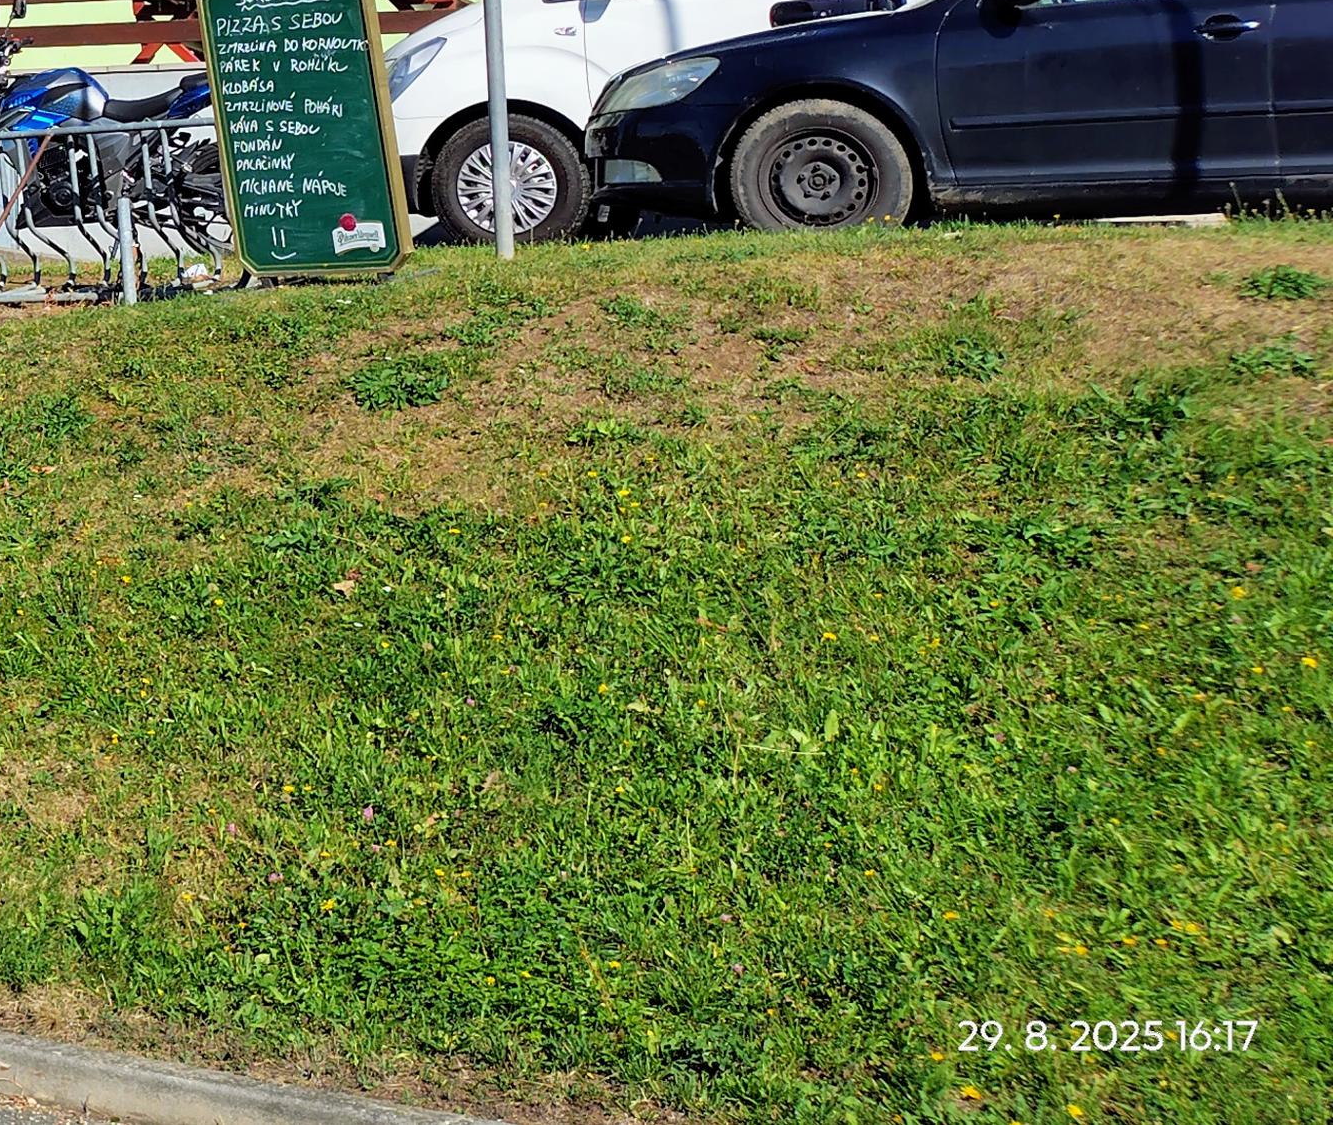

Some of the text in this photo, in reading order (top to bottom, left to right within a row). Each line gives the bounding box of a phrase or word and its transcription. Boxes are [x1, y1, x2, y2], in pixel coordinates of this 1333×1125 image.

[216, 12, 343, 37] PIZZA S SEBOU
[284, 38, 299, 53] DO
[220, 56, 349, 74] PÁREK V ROHLÍKU
[222, 77, 275, 95] KLOBÁSA
[229, 115, 321, 136] KÁVA S SEBOU
[233, 133, 282, 154] FONDÁN
[239, 170, 348, 198] MÍCHANÉ NÁPOJE
[244, 199, 303, 220] MINUTKY
